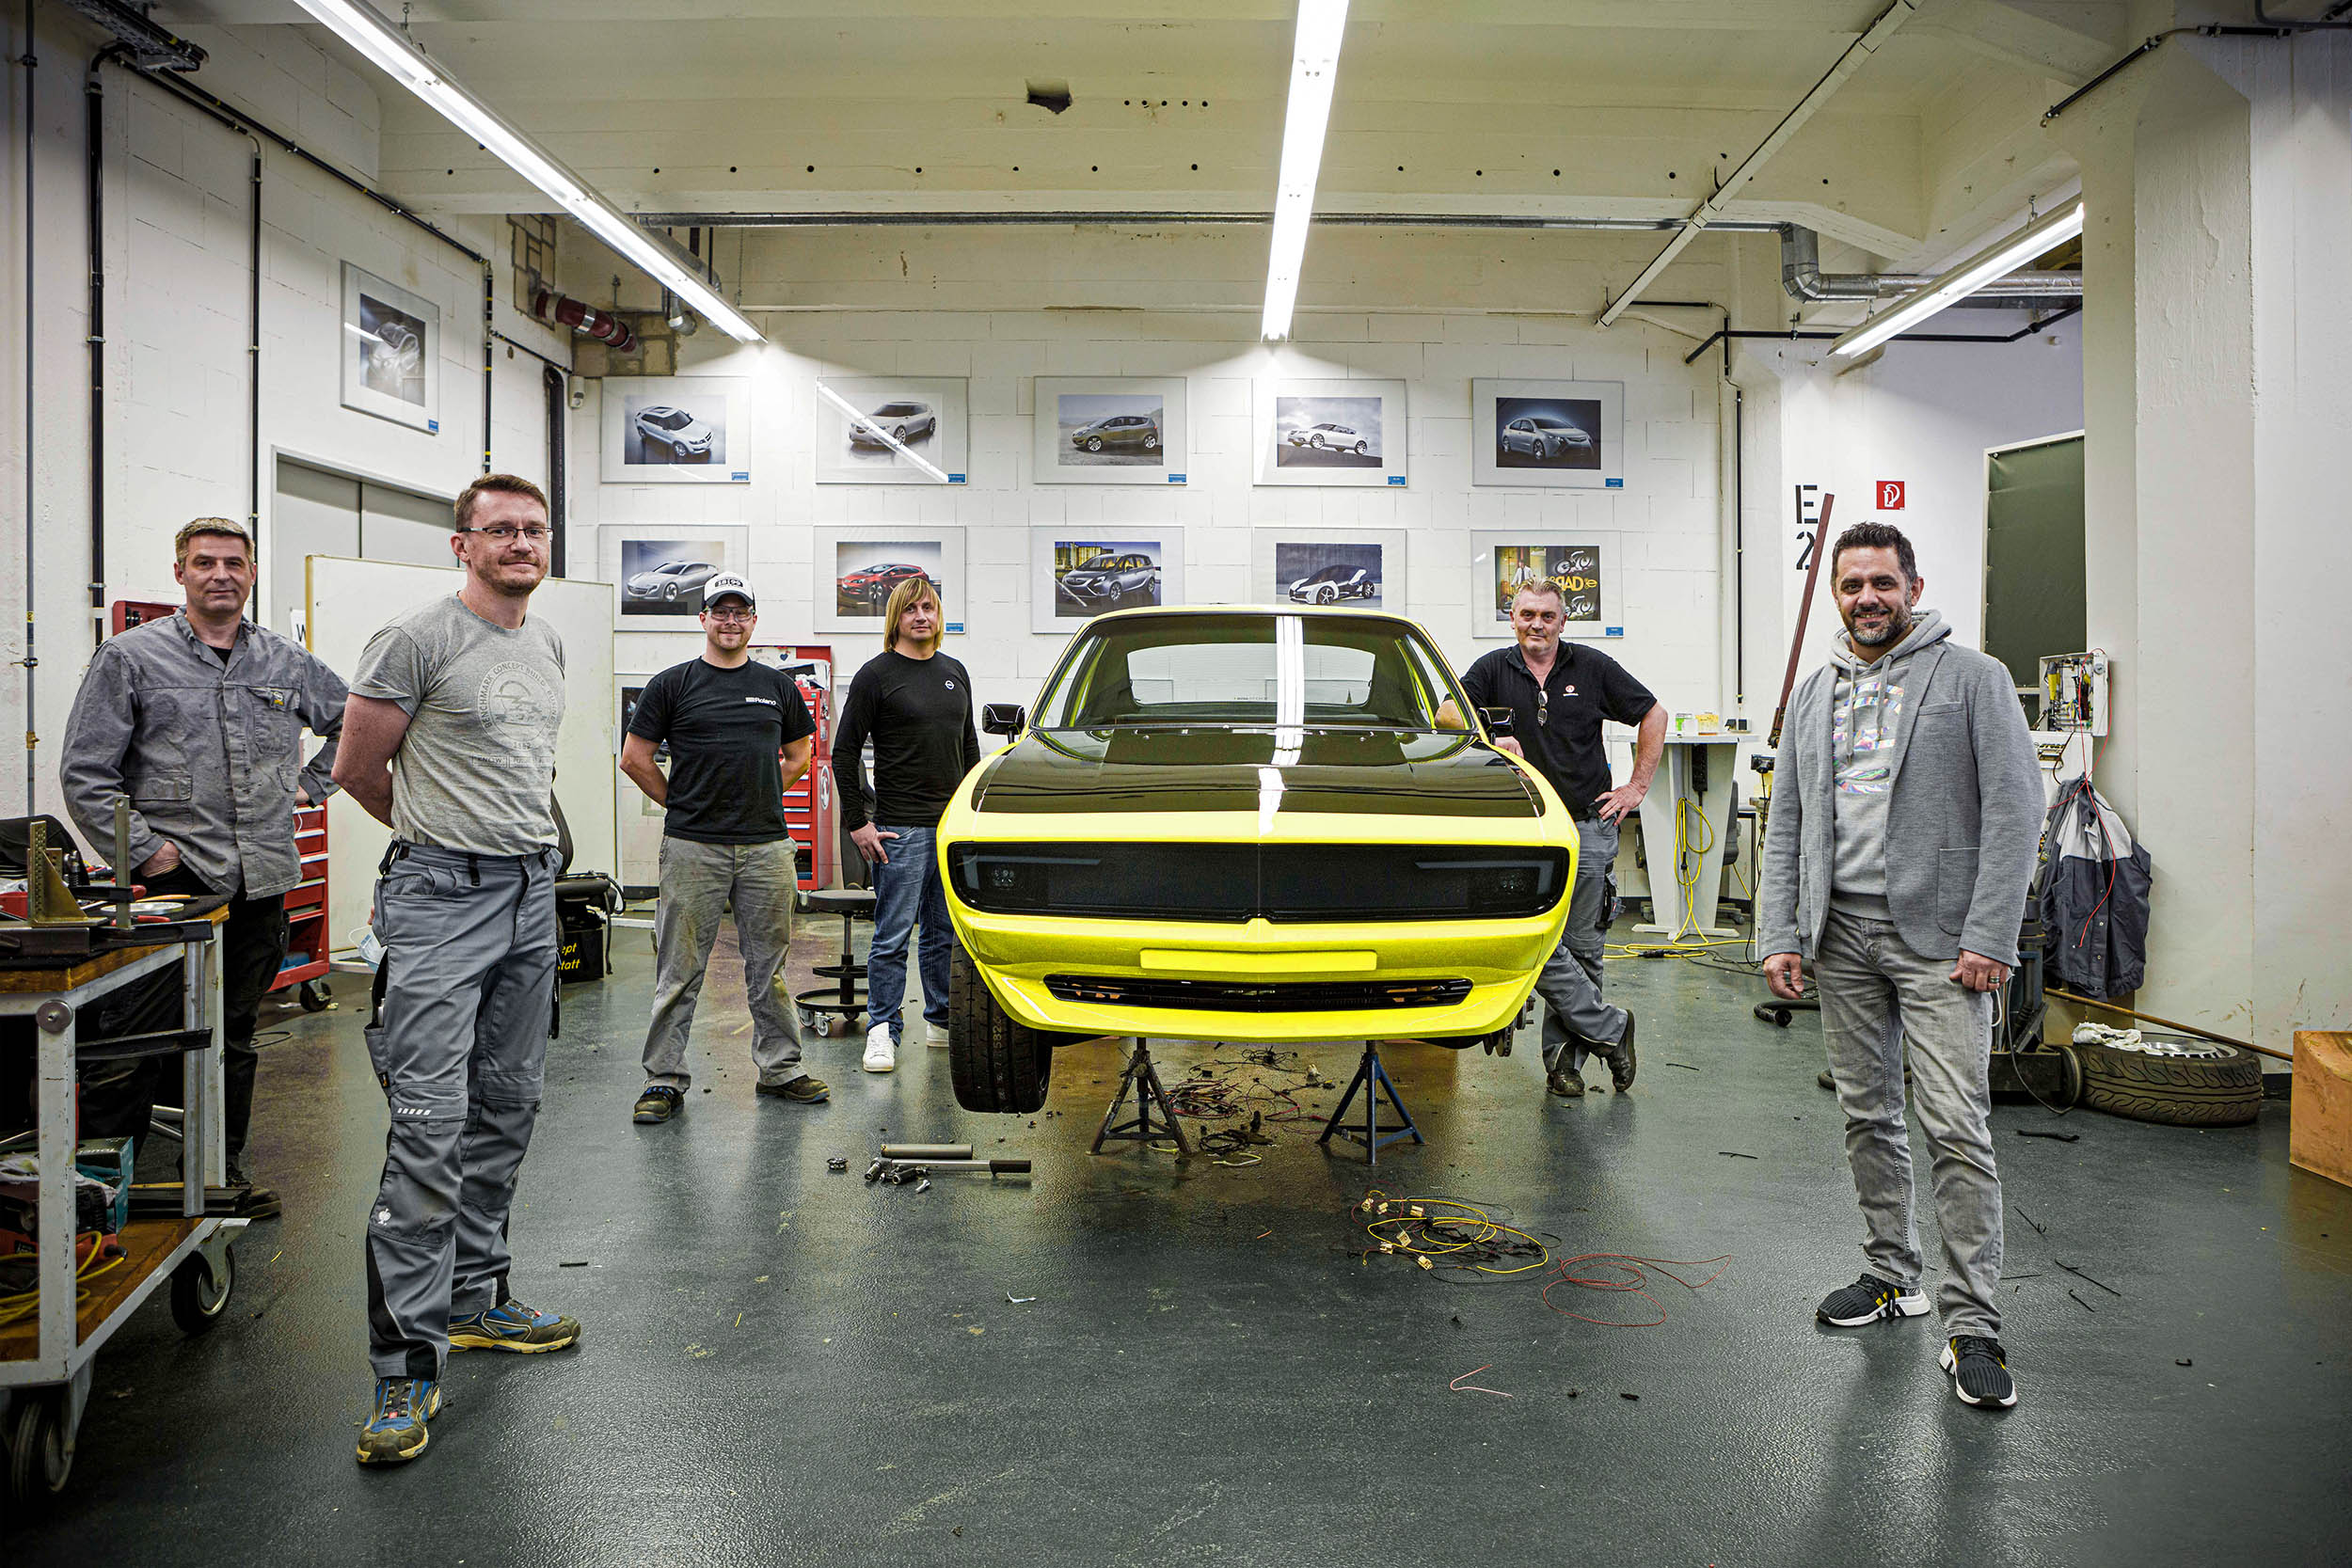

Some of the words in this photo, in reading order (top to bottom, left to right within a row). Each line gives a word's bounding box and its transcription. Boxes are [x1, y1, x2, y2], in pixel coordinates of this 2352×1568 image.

[1795, 484, 1818, 524] E
[1796, 531, 1816, 570] 2
[479, 676, 493, 729] BENCHMARK
[493, 662, 525, 675] CONCEPT
